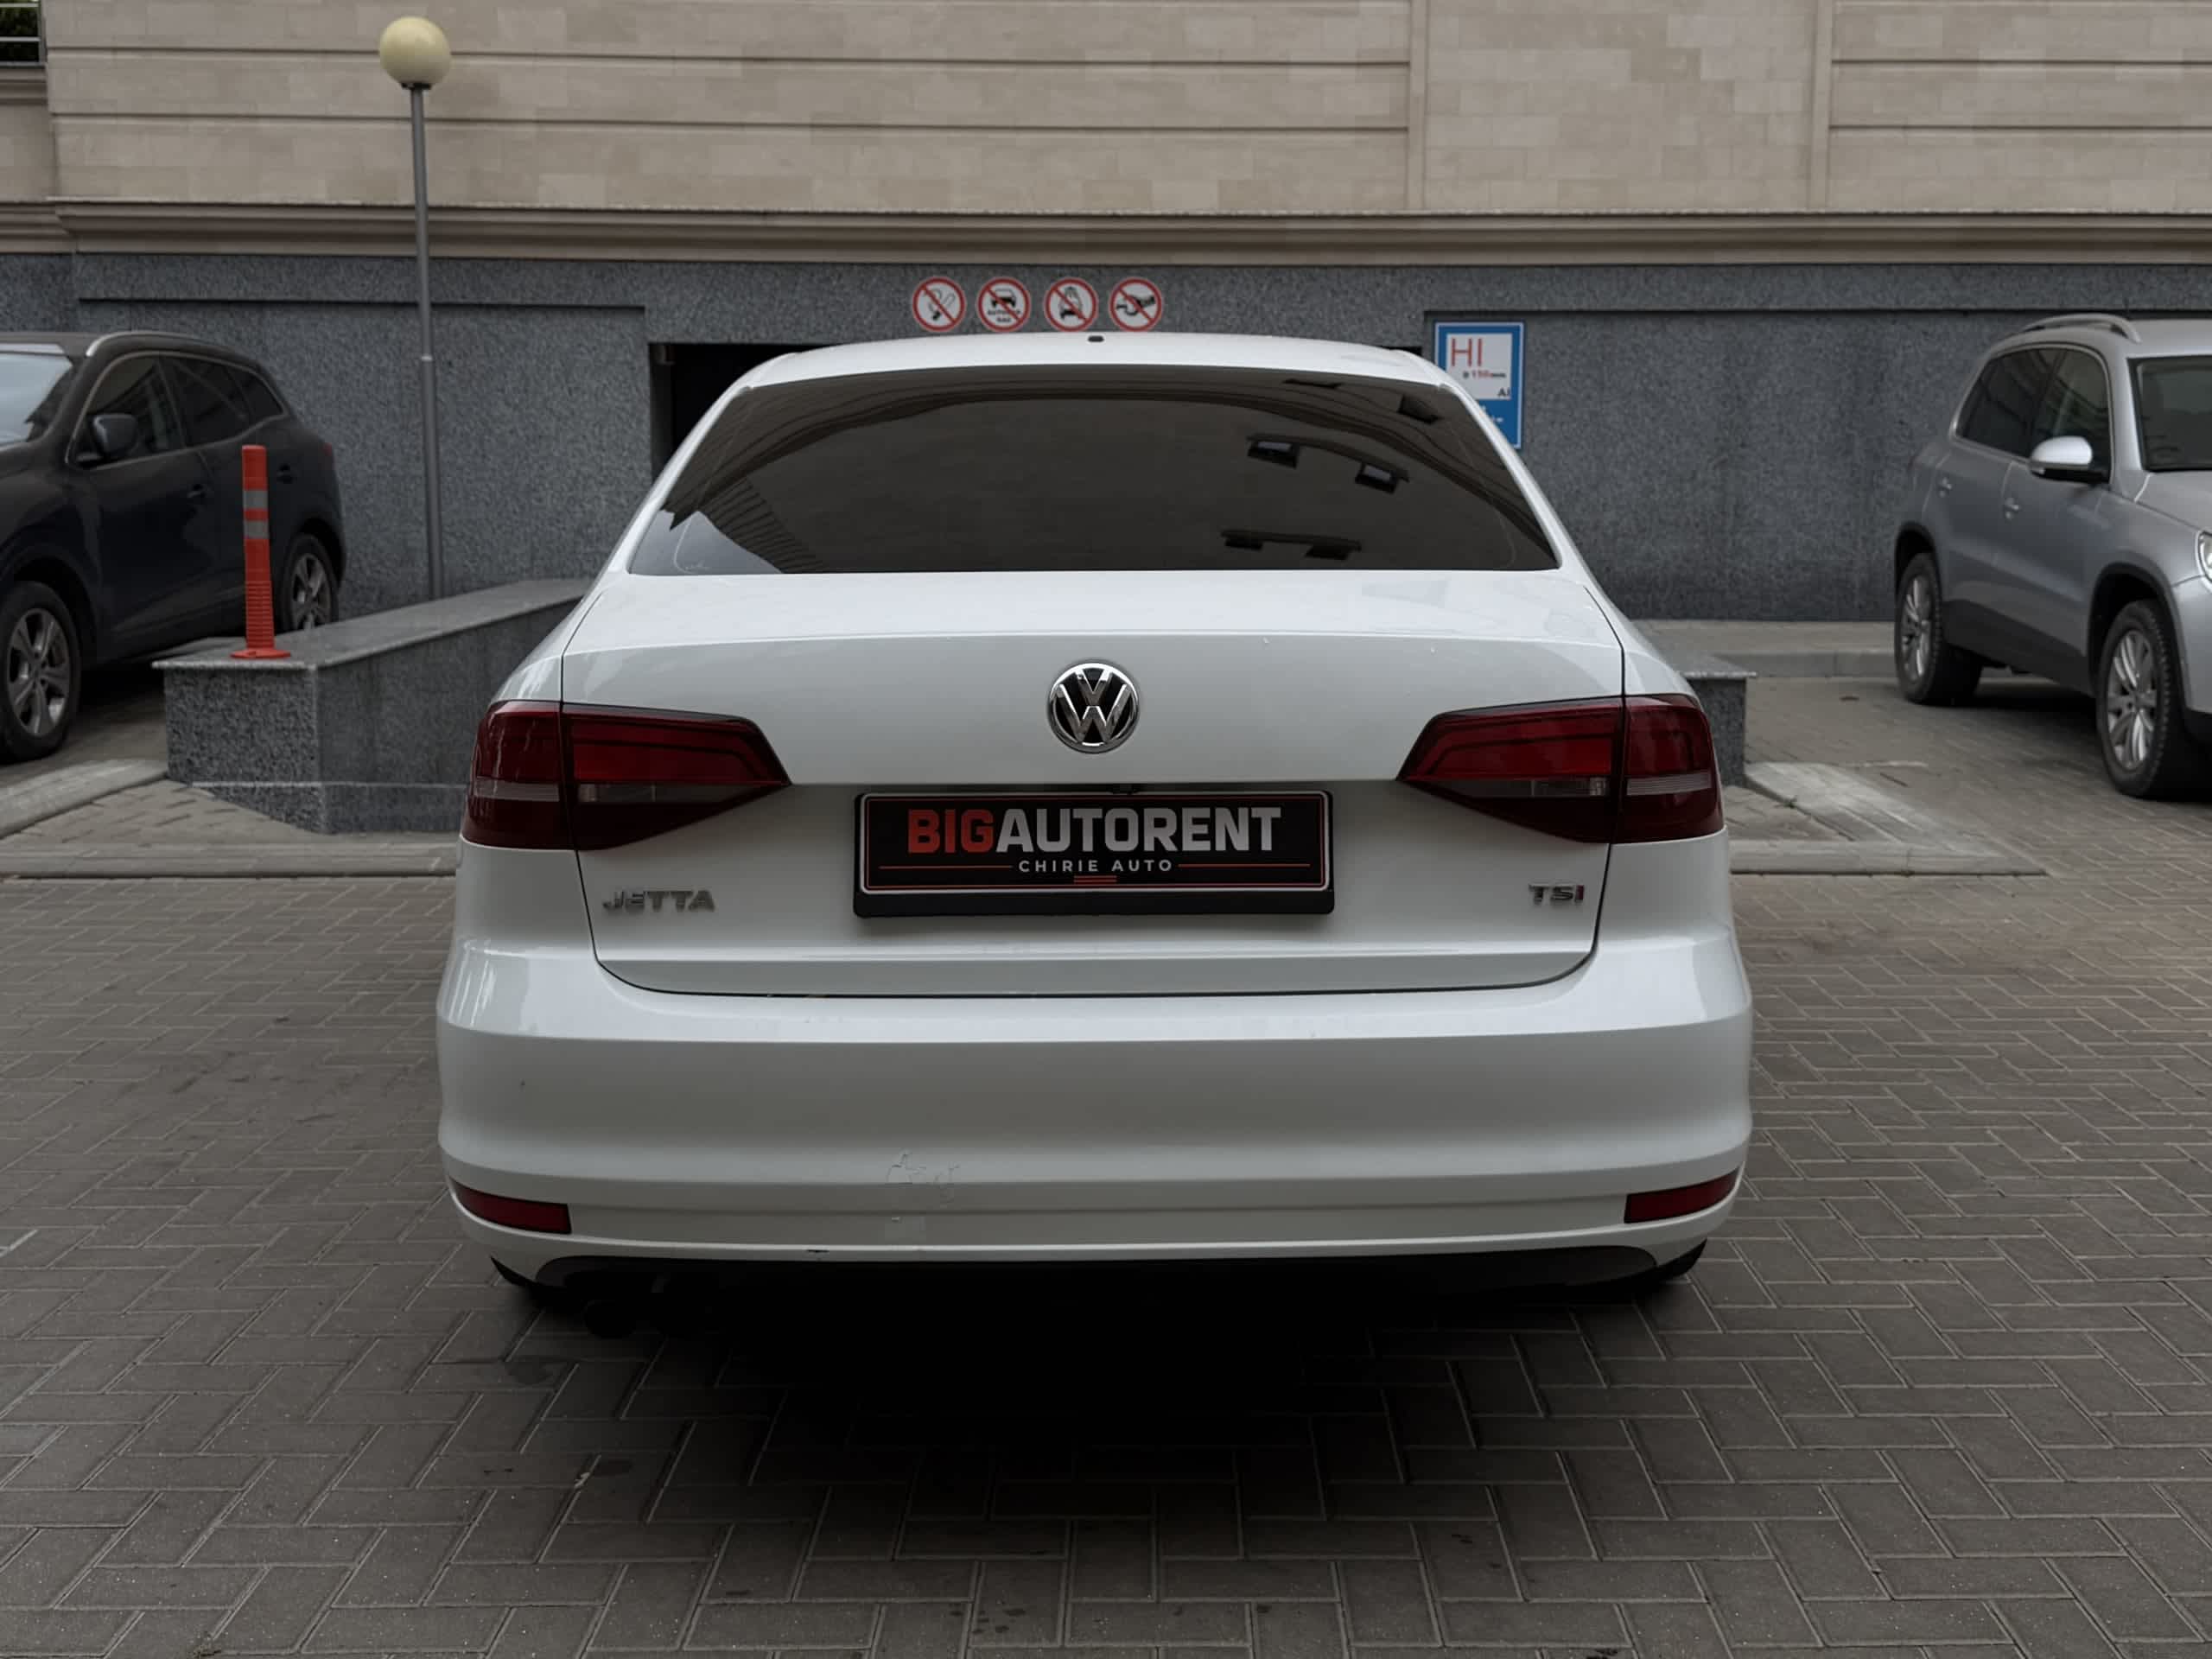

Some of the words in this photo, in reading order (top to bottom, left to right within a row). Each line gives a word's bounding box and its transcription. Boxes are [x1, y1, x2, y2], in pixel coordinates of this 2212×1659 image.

[908, 807, 1281, 854] BIGAUTORENT
[1018, 859, 1099, 873] CHIRIE
[1111, 858, 1173, 872] AUTO
[603, 890, 716, 913] JETTA
[1528, 884, 1585, 906] TSI
